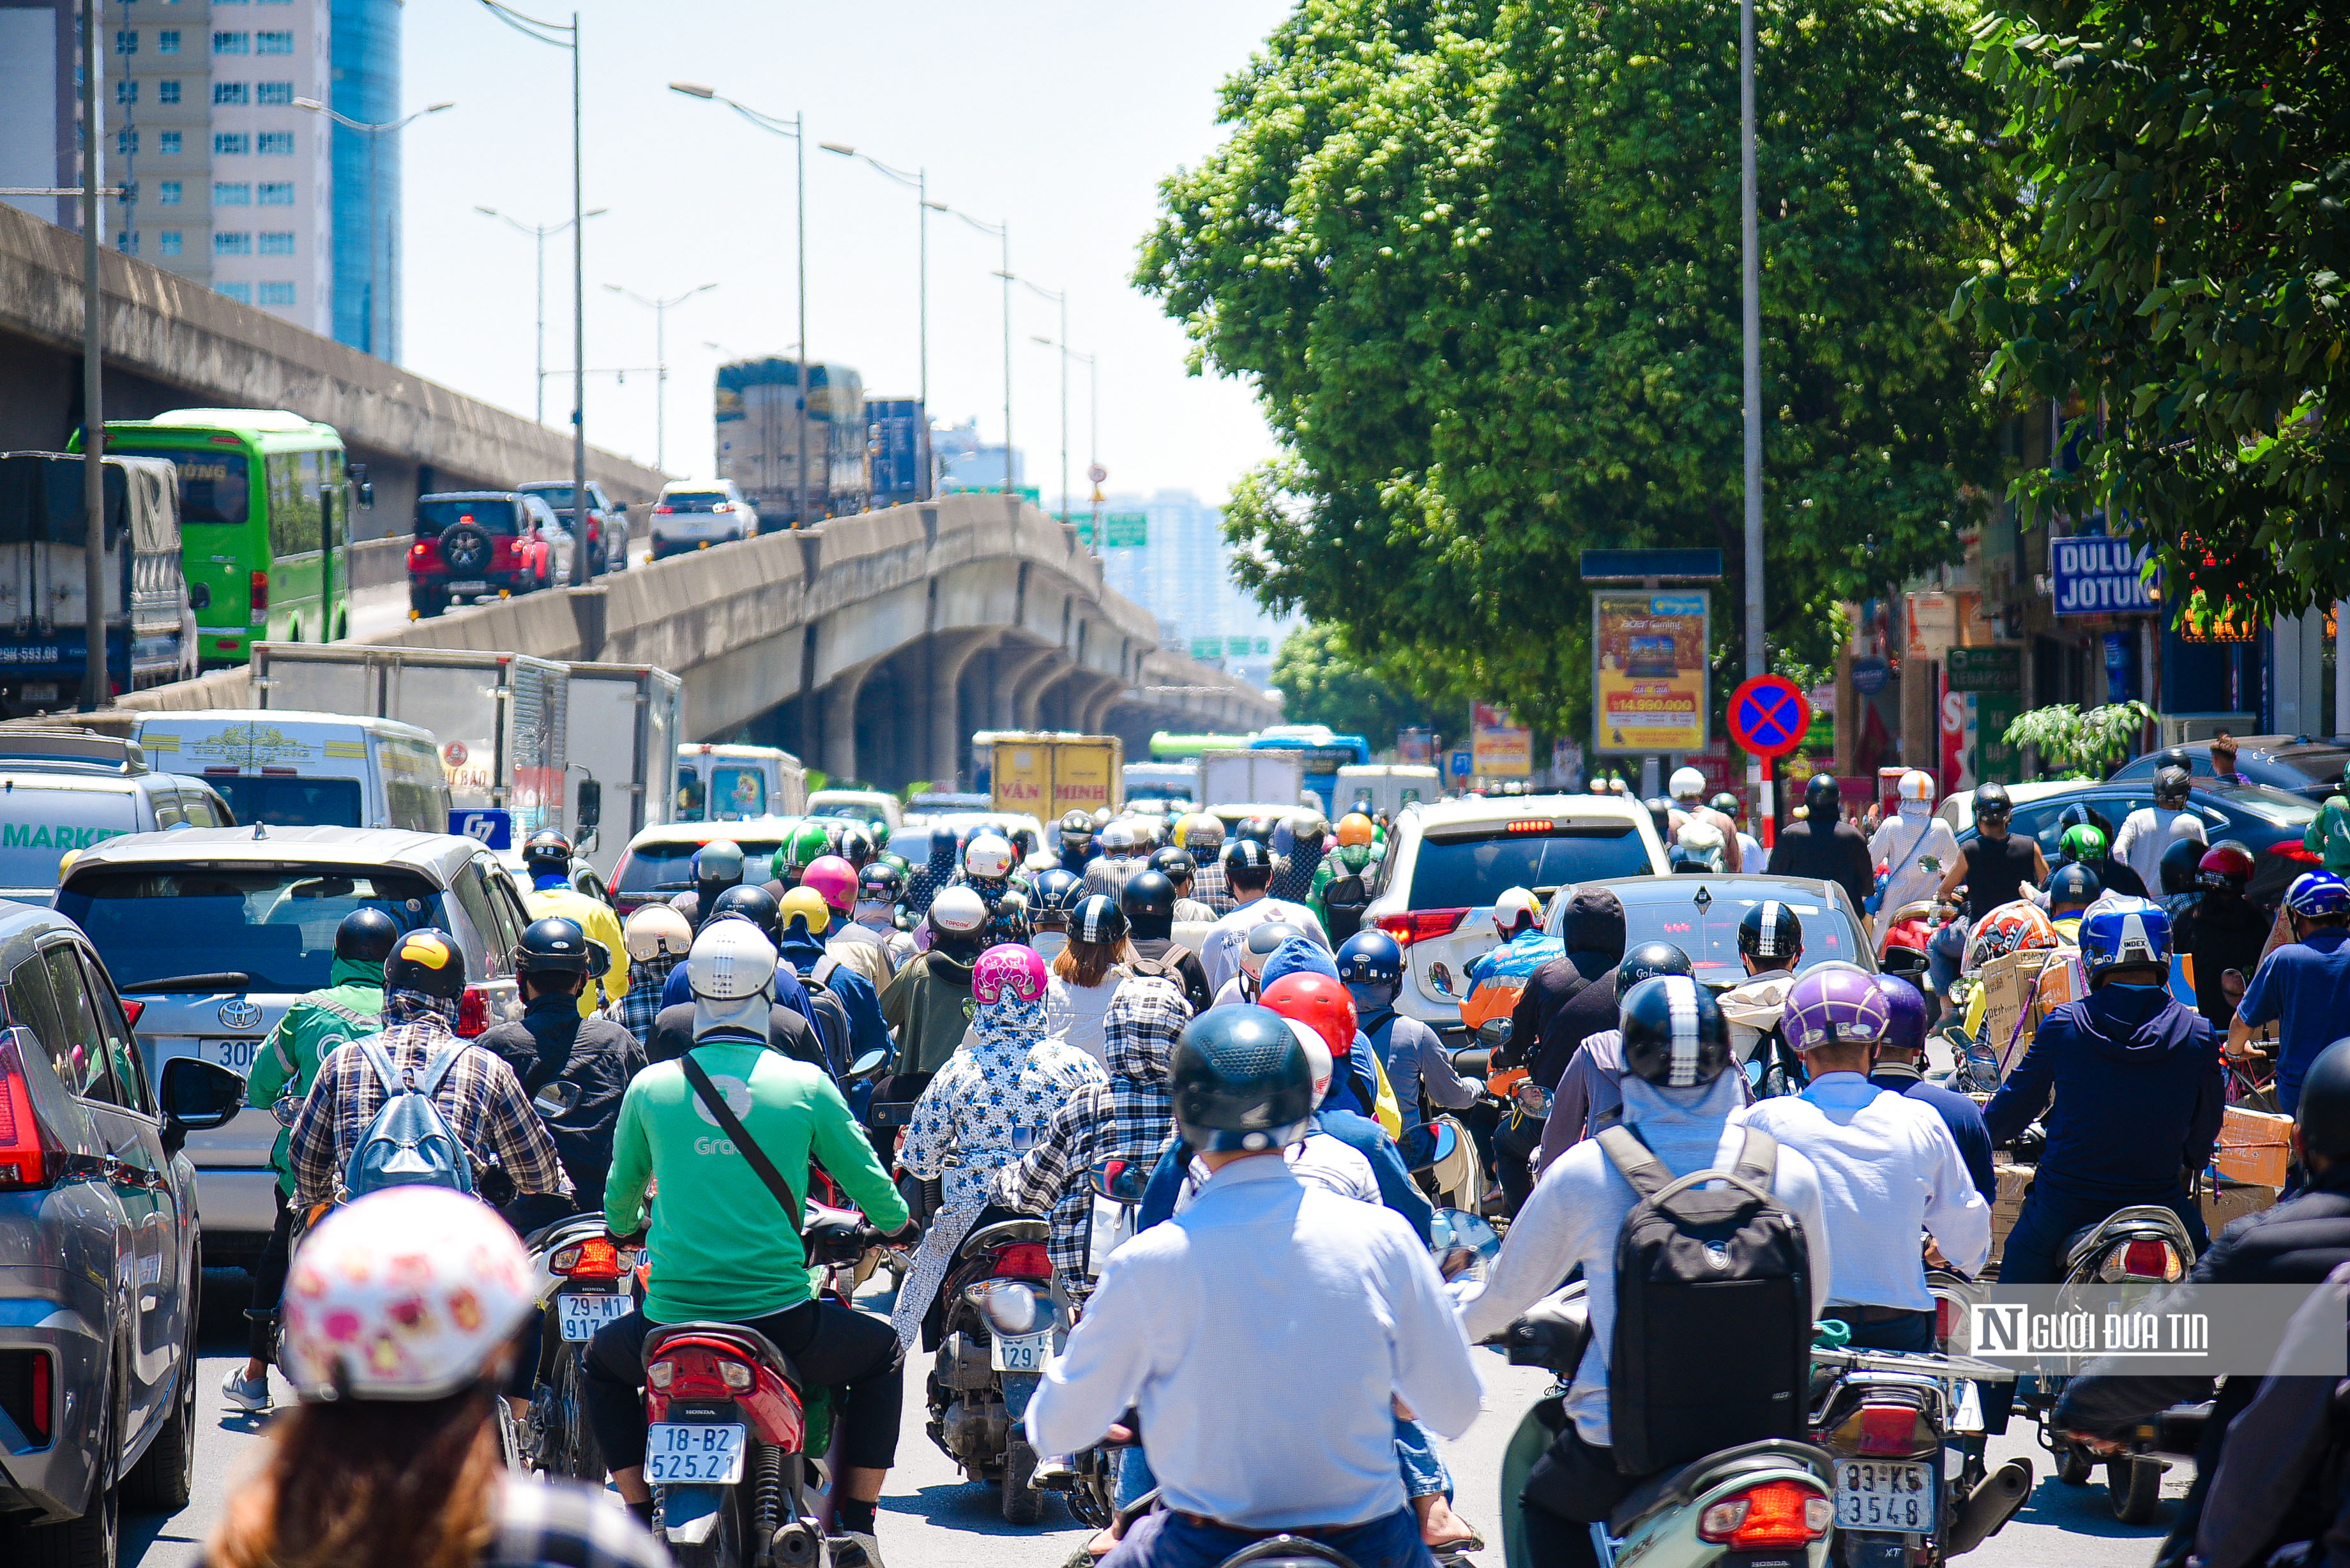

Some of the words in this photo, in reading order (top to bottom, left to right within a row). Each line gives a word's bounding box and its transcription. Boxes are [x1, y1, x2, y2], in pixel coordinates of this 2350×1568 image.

[694, 1136, 741, 1155] Gra
[570, 1297, 621, 1316] 29-M1
[665, 1428, 729, 1452] 18-B2
[652, 1454, 734, 1479] 525.21
